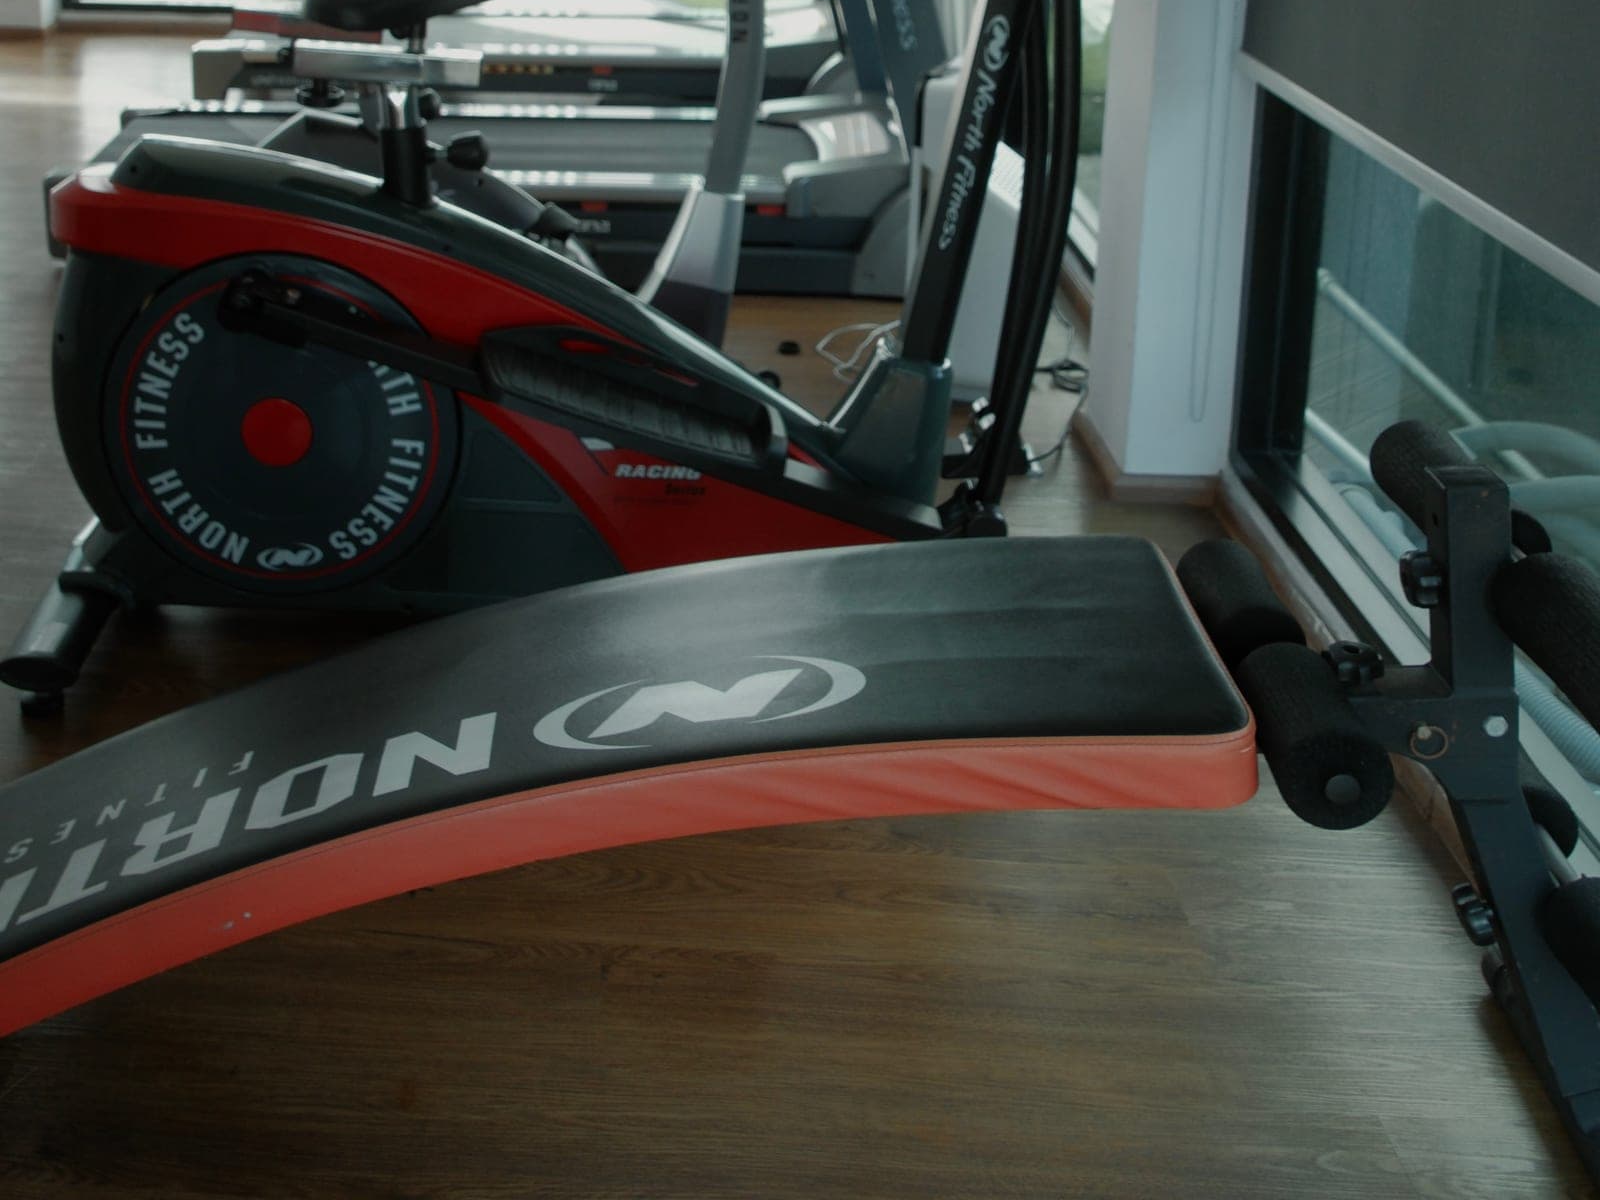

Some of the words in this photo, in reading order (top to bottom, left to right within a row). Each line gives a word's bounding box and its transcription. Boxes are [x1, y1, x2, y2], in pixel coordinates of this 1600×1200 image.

[963, 68, 997, 151] North
[938, 154, 976, 250] Fitness
[134, 312, 205, 450] FITNESS
[147, 468, 250, 564] NORTH
[328, 438, 425, 560] FITNESS
[4, 750, 255, 864] FITNES
